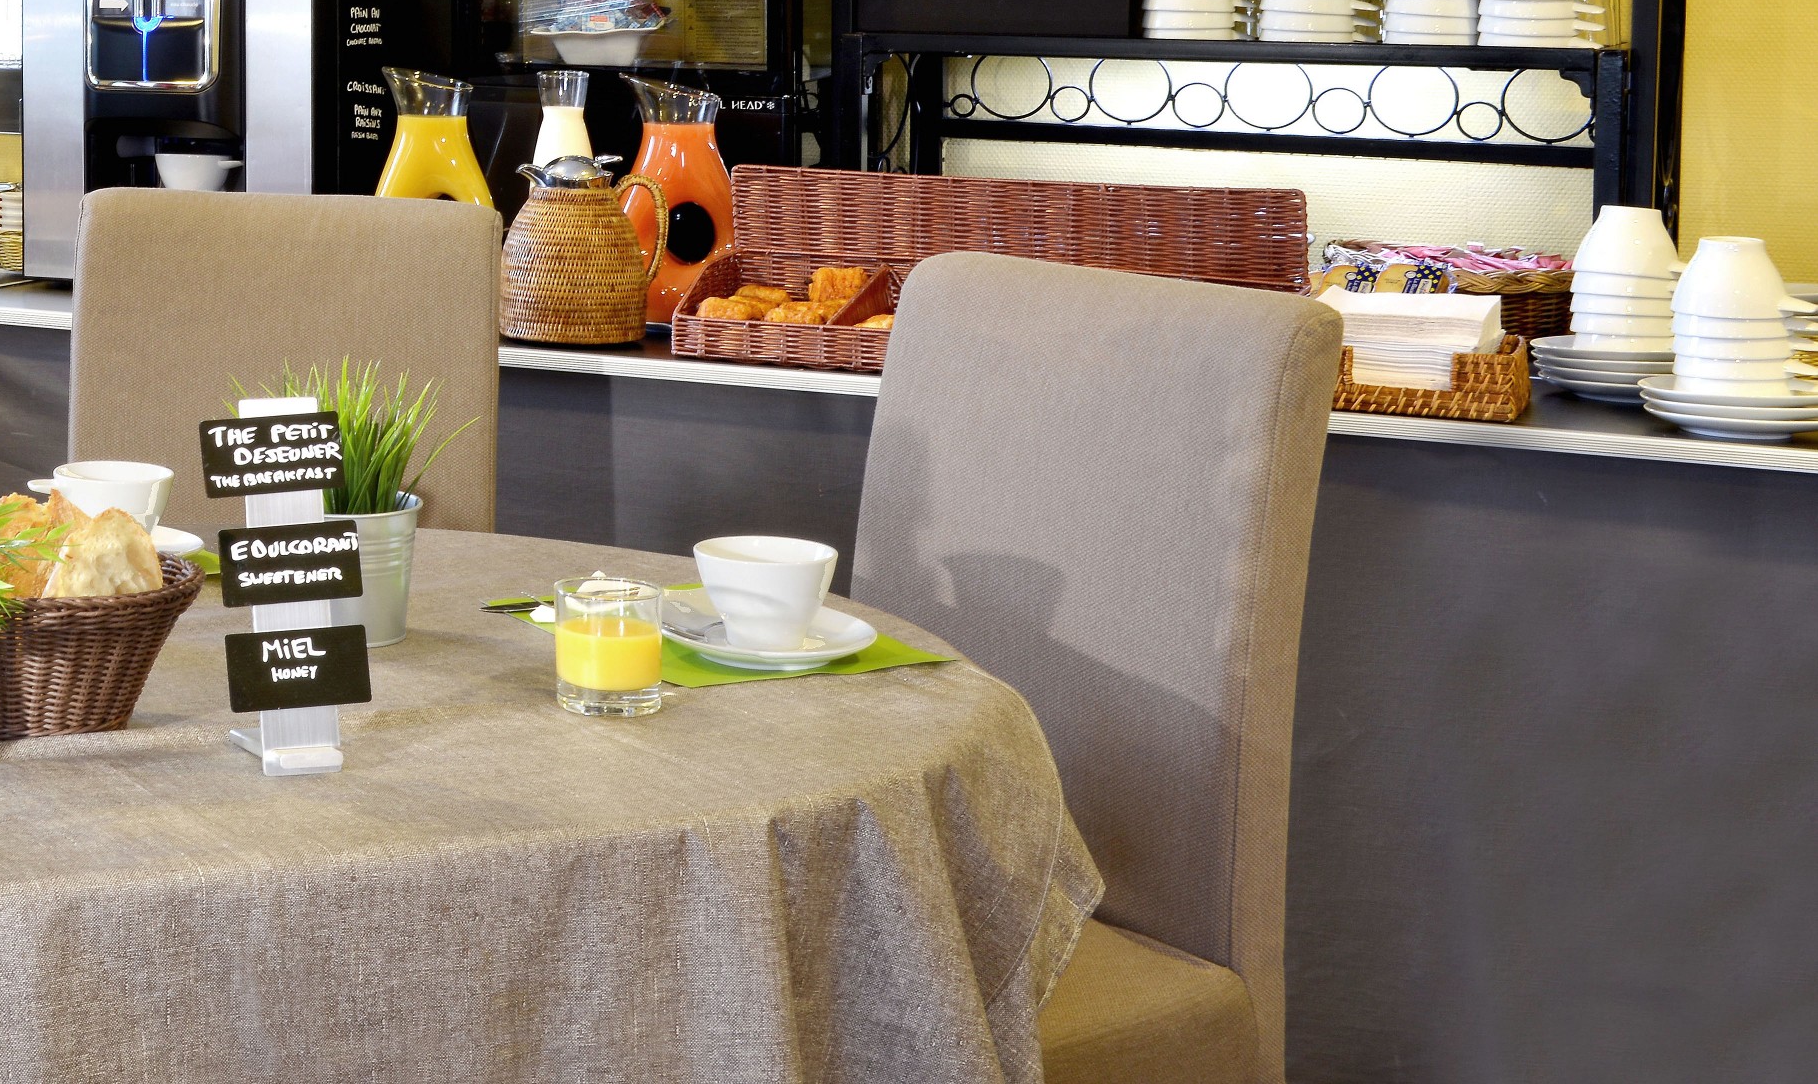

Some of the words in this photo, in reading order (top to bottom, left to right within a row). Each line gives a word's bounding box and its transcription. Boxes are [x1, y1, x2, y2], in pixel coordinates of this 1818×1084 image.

[208, 425, 258, 448] THE
[210, 475, 241, 489] THE
[242, 467, 337, 487] BREAKFAST
[231, 531, 359, 562] EDULCORANT
[238, 568, 343, 587] SWEETENER
[271, 665, 319, 682] HONEY
